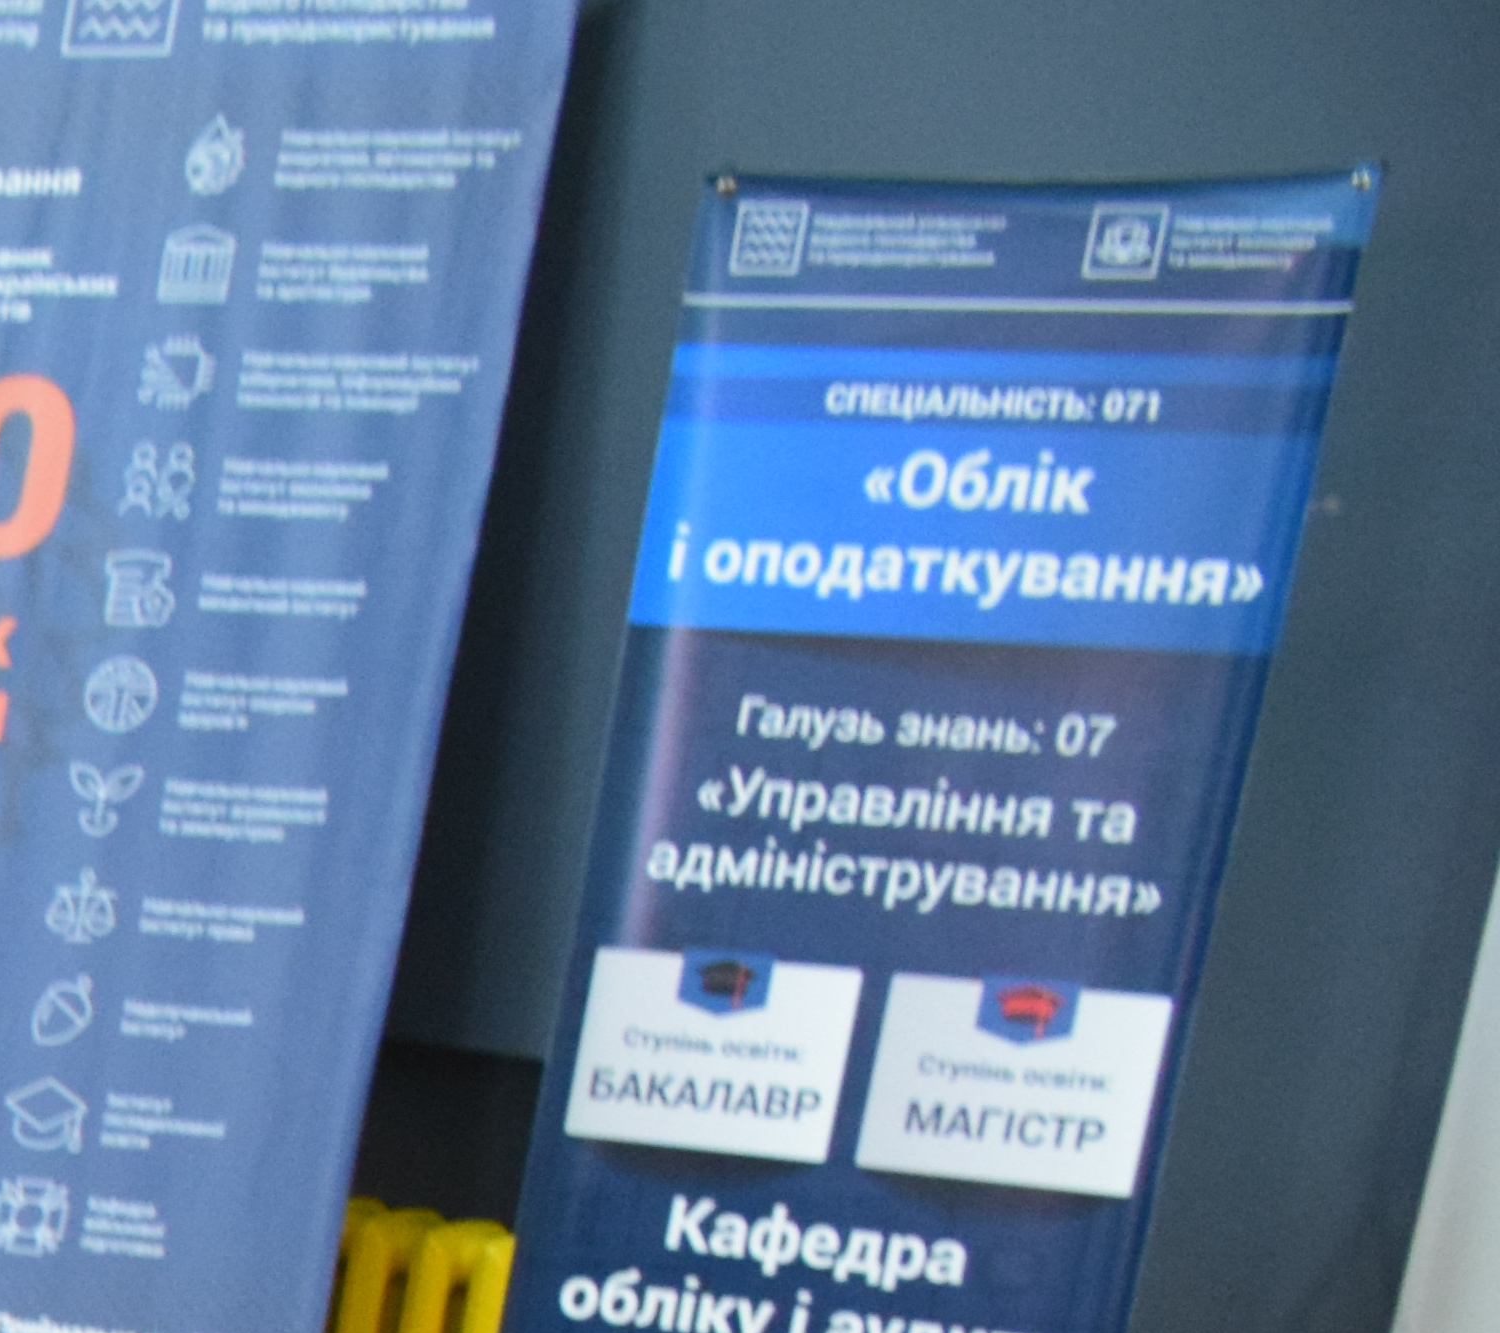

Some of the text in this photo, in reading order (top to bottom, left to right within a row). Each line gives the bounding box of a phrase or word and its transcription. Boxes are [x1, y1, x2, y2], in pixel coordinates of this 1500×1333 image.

[825, 381, 1163, 423] СПЕЦІАЛЬНІСТЬ: 071
[863, 449, 1092, 517] «Облік
[666, 522, 1264, 609] і оподаткування»
[736, 694, 1117, 759] Галузь знань: 07
[697, 766, 1137, 844] «Управління та
[645, 837, 1162, 919] адміністрування»
[621, 1025, 717, 1060] Ступінь
[917, 1053, 1015, 1092] Ступінь
[587, 1064, 823, 1125] БАКАЛАВР
[903, 1098, 1107, 1154] МАГІСТР
[663, 1194, 969, 1292] Кафедра
